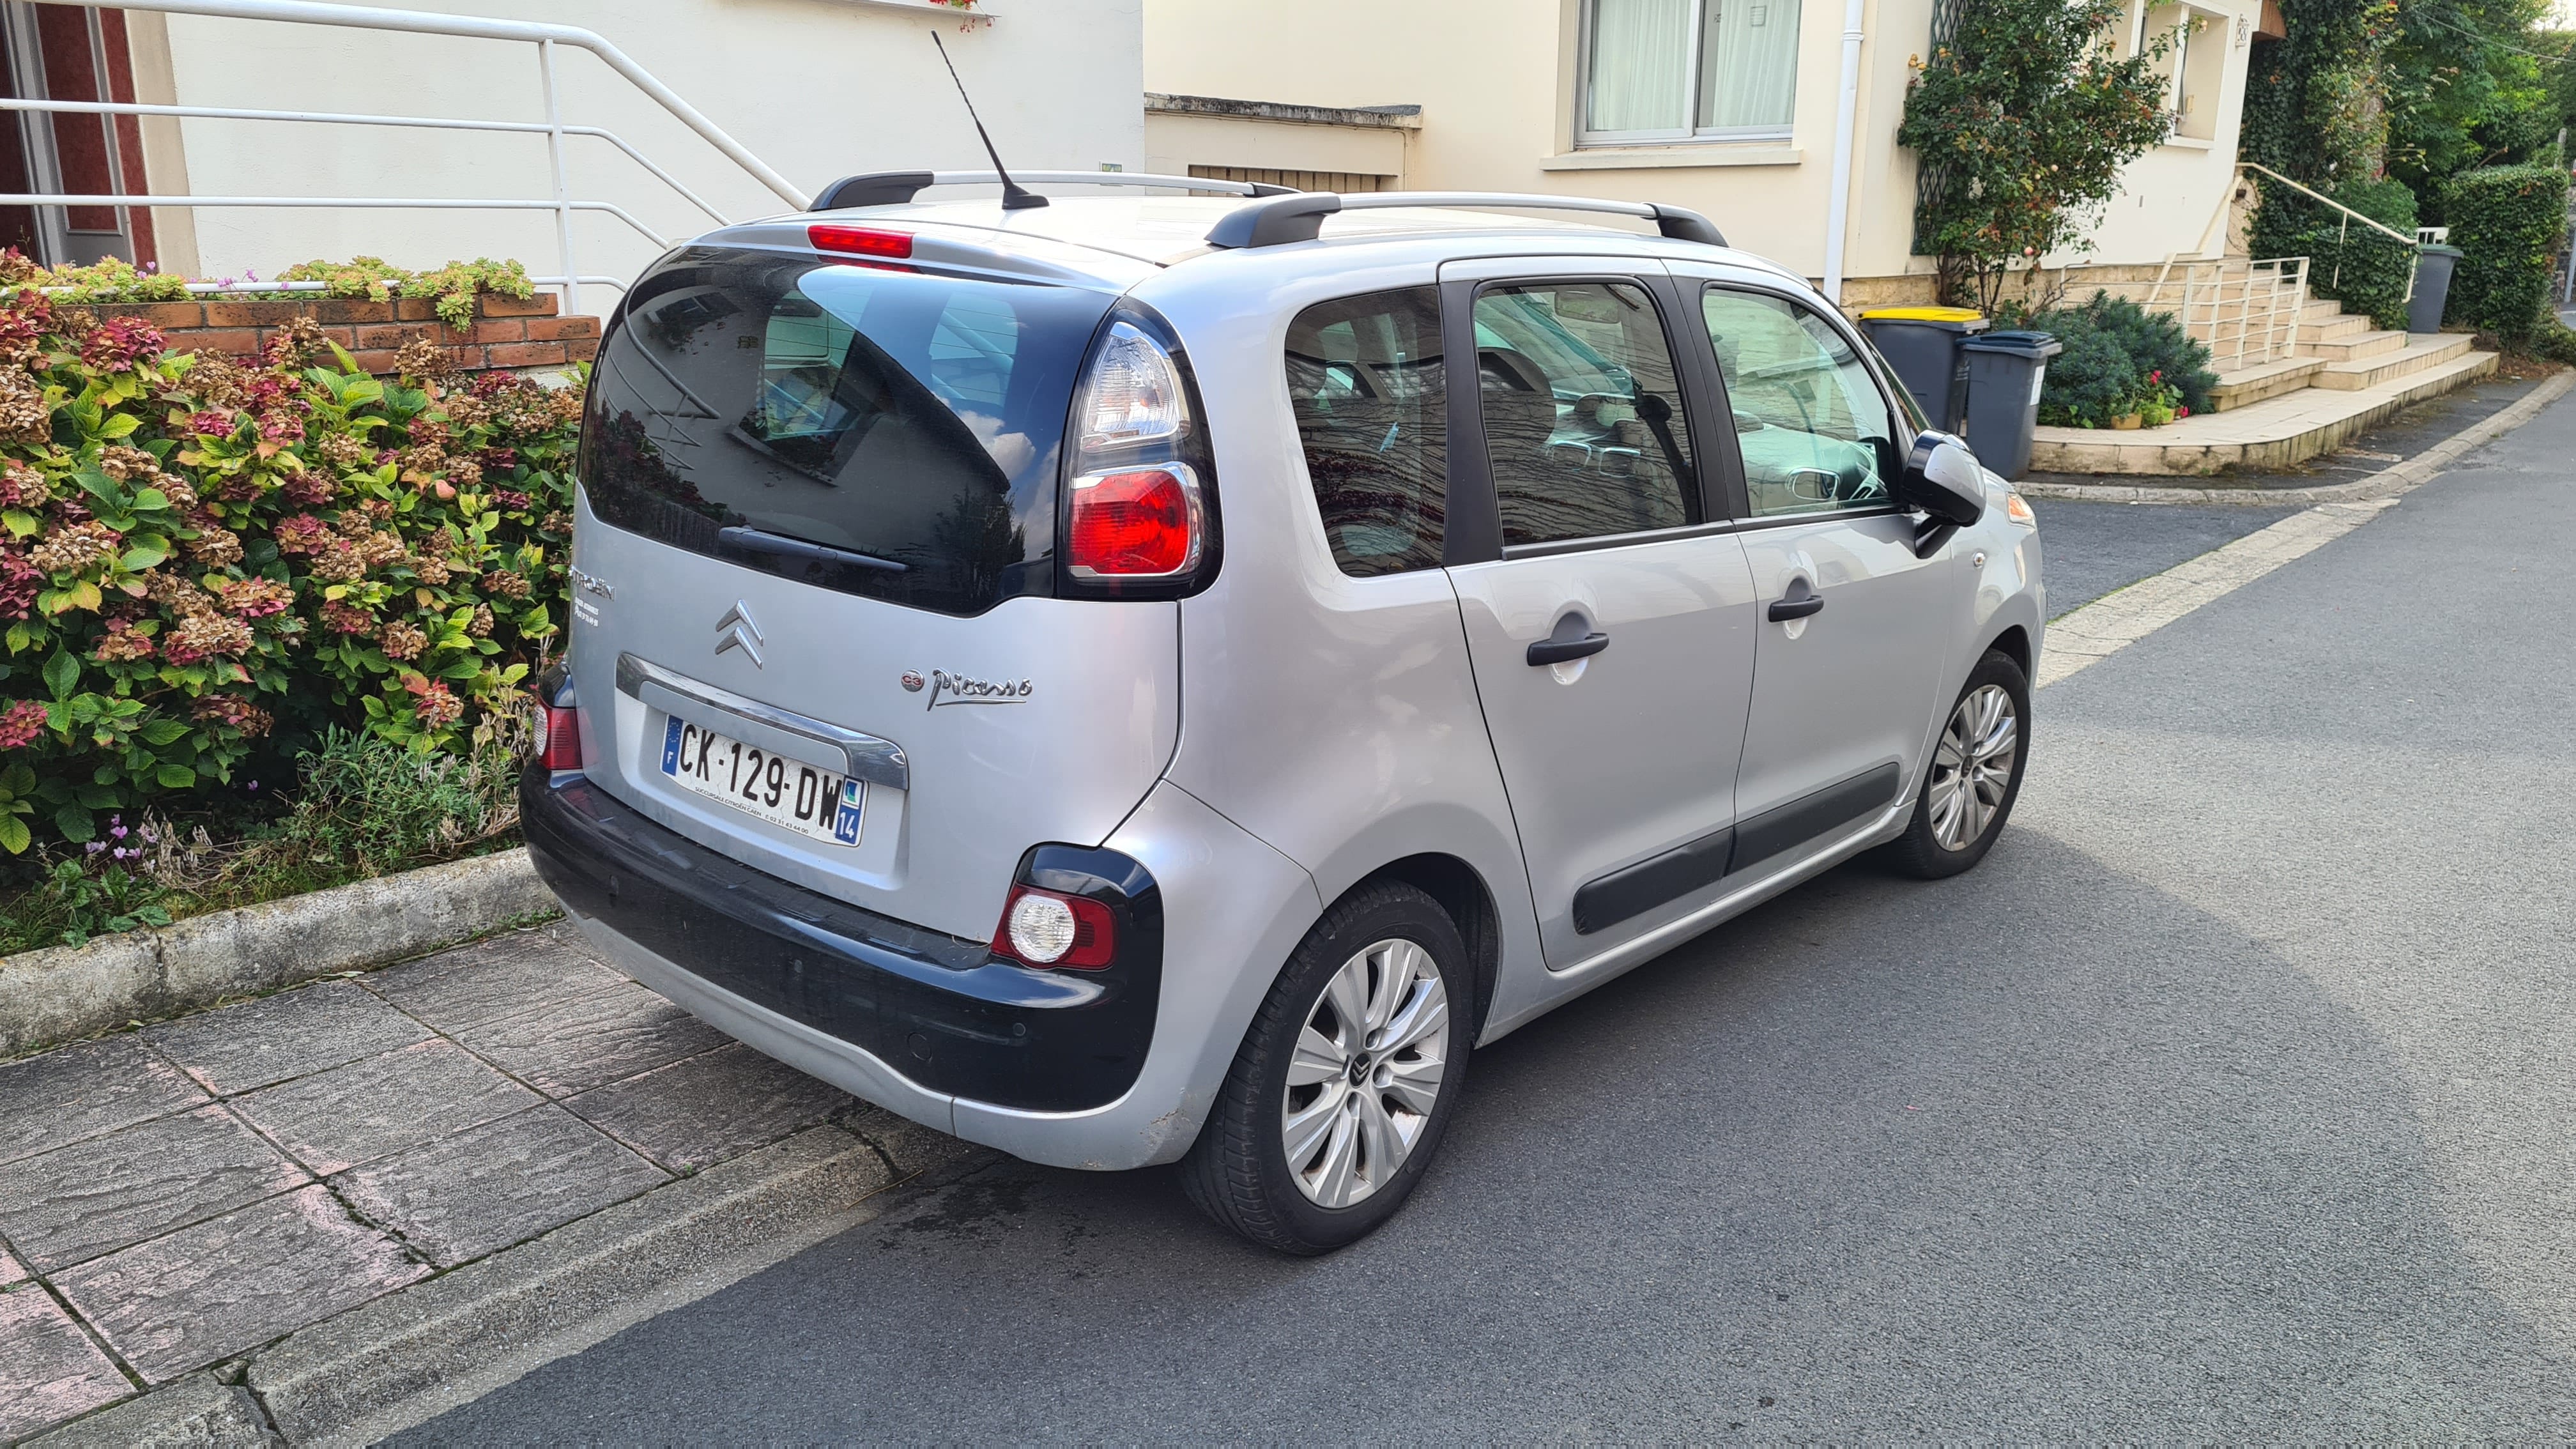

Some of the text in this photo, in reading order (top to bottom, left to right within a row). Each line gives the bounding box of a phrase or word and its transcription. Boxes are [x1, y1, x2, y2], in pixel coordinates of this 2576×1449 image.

[901, 667, 1033, 712] C3 Picasso
[666, 751, 674, 764] F
[680, 724, 843, 831] CK-129-DW
[694, 786, 724, 802] SUCCURSALE
[746, 807, 762, 817] CAEN
[839, 811, 855, 838] 14
